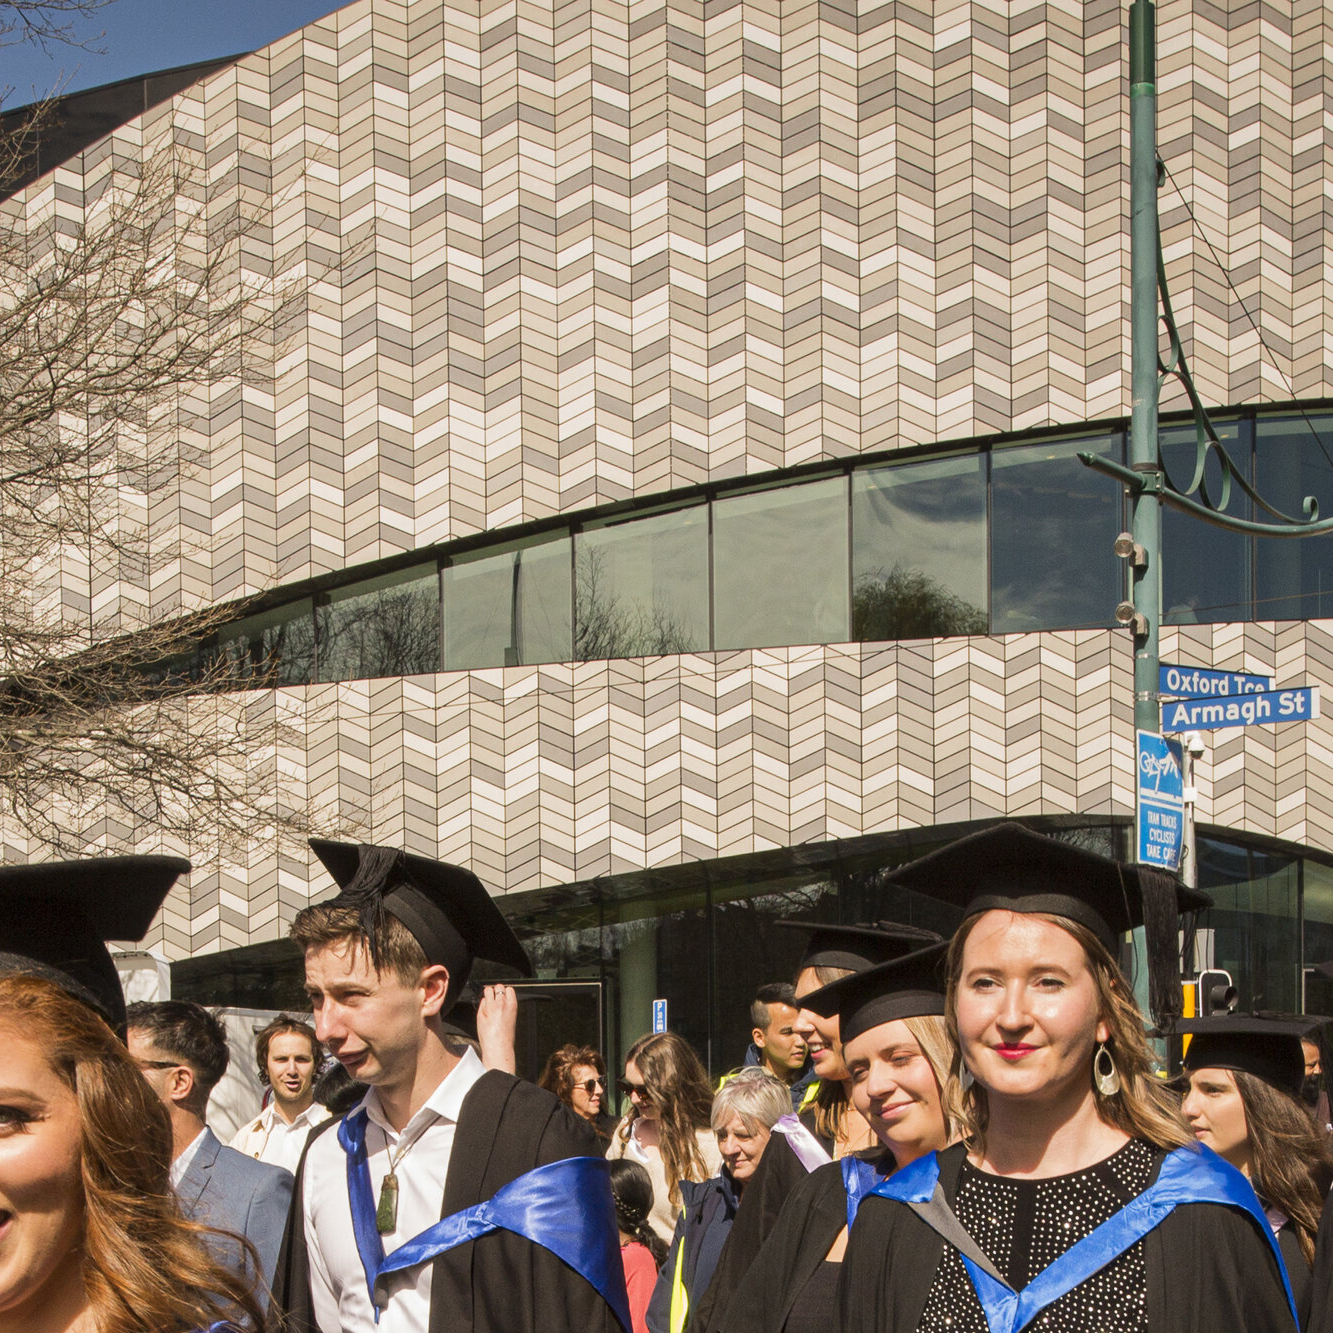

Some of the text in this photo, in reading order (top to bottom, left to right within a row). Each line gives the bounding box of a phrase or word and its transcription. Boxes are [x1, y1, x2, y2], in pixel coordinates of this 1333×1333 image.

[1166, 669, 1229, 696] Oxford
[1171, 691, 1305, 727] Armagh St
[1147, 810, 1177, 829] TRAM TRACKS
[1149, 828, 1175, 846] CYCLISTS
[1146, 843, 1161, 859] TAKE
